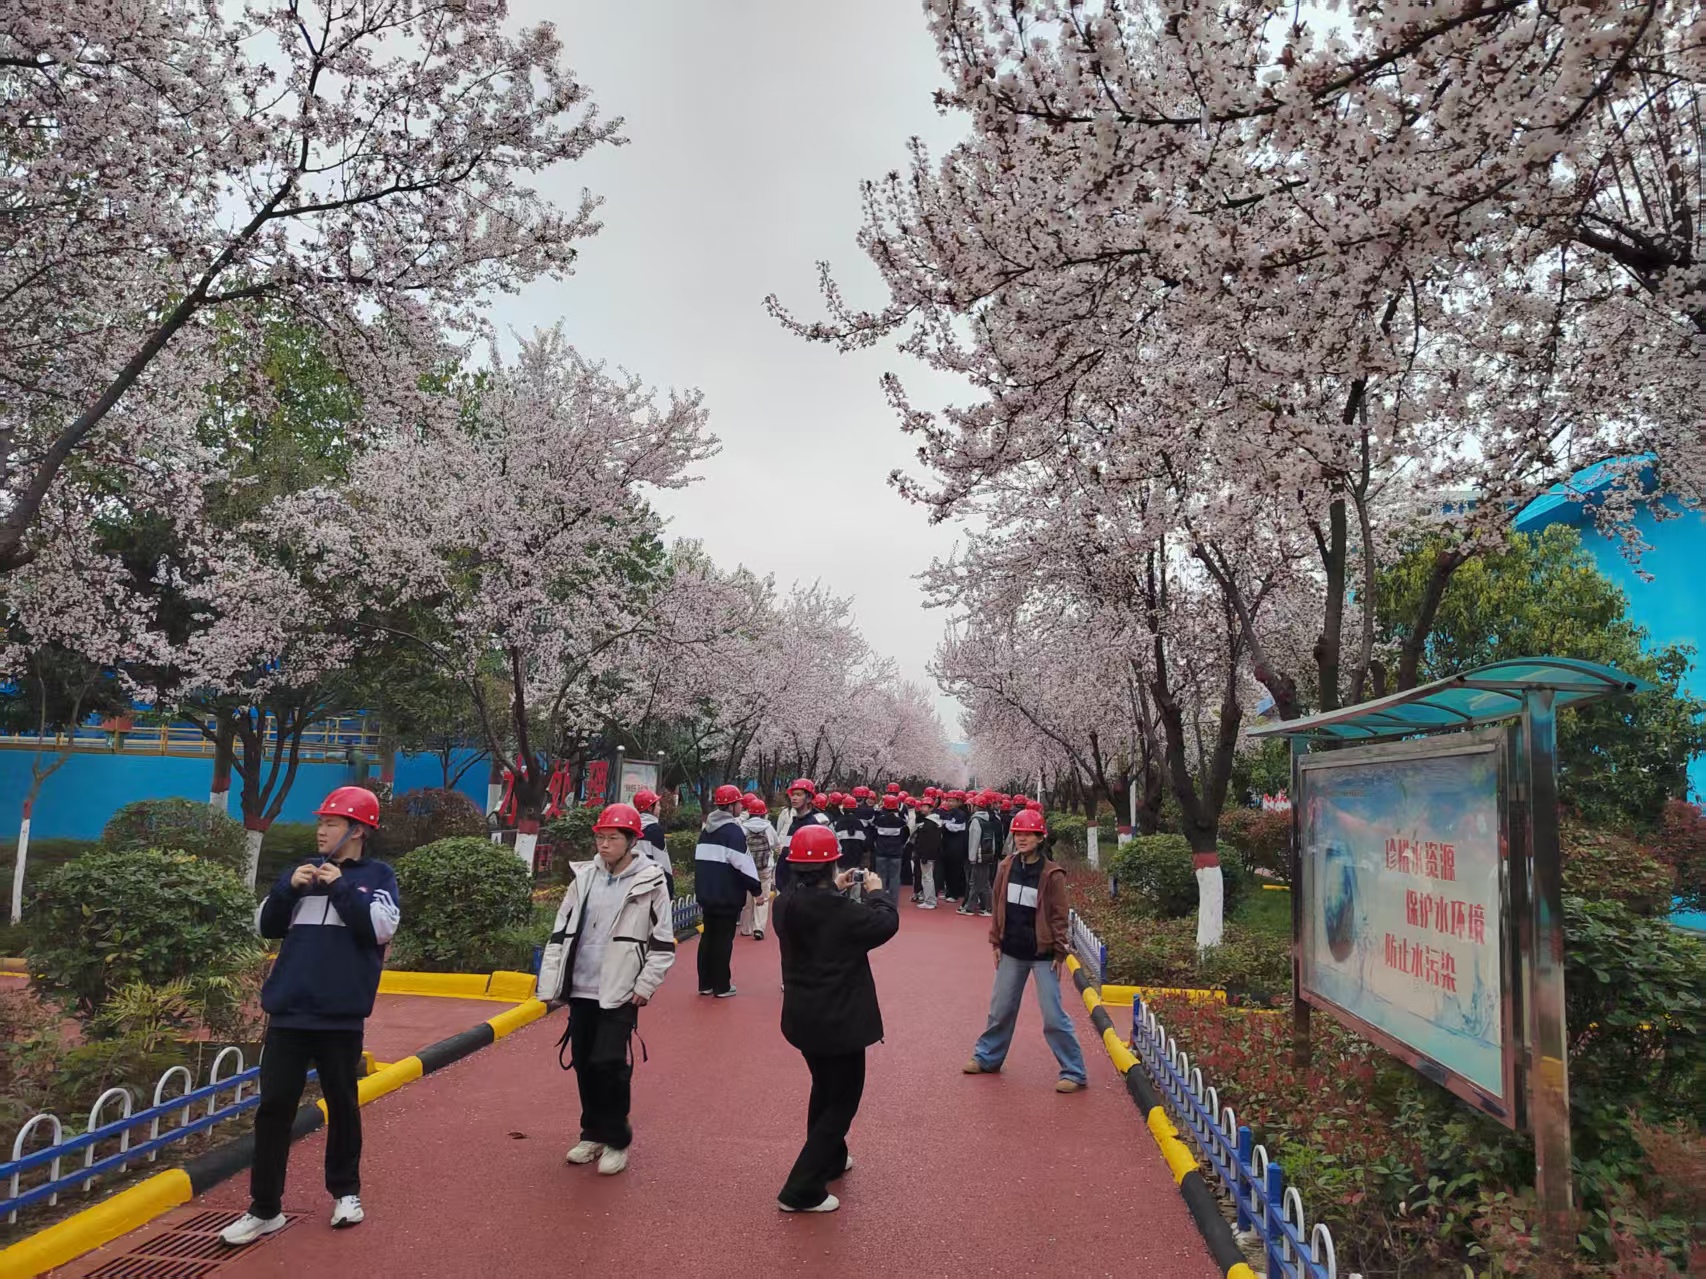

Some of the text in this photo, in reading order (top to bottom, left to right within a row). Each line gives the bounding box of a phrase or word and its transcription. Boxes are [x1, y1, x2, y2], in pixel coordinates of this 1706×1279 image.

[1385, 838, 1456, 882] 珍惜水资源
[1405, 888, 1486, 945] 保护水环境
[1385, 933, 1457, 993] 防止水污染
